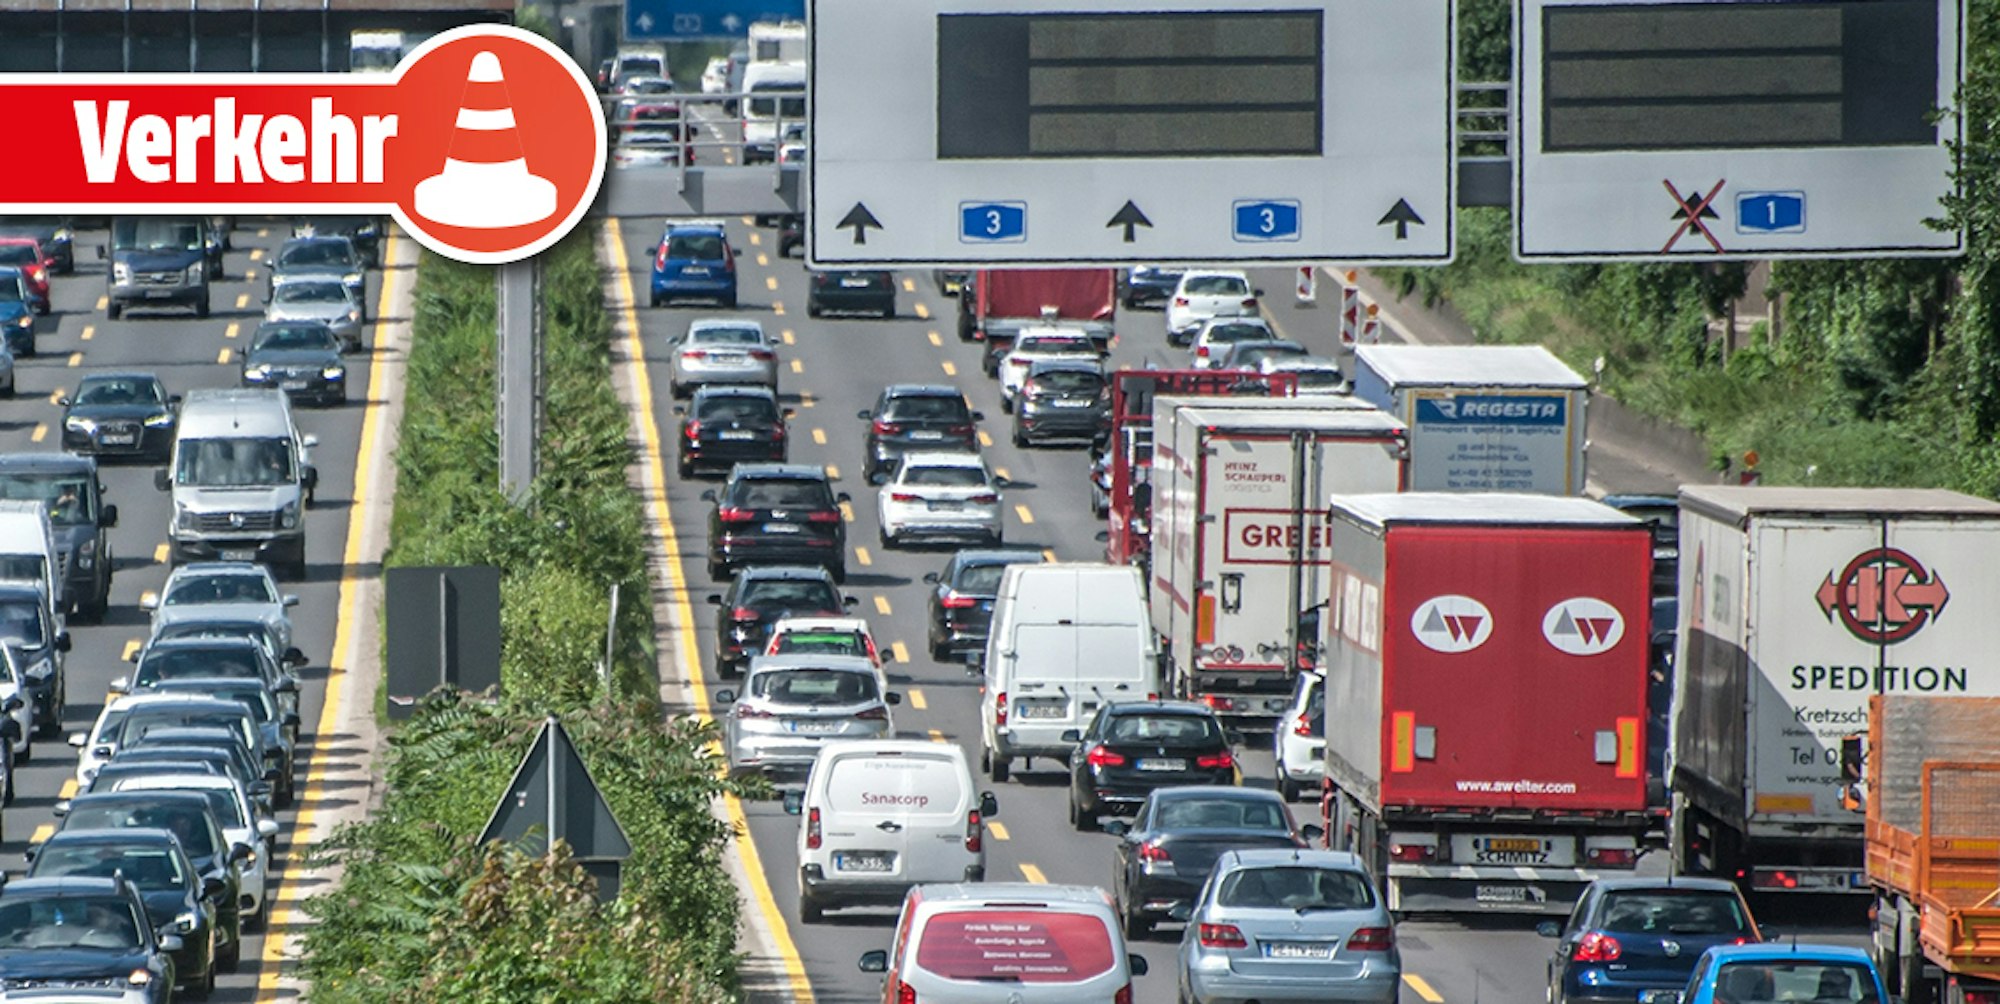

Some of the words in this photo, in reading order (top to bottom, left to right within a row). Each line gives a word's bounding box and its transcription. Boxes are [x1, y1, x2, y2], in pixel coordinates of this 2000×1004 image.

[1259, 208, 1275, 233] 3
[1766, 200, 1776, 225] 1
[985, 209, 1001, 235] 3
[1462, 402, 1557, 418] REGESTA
[1225, 463, 1257, 471] HEINZ
[1791, 666, 1967, 692] SPEDITION
[1790, 747, 1815, 765] Tel
[862, 792, 929, 808] Sanacorp
[1476, 850, 1548, 863] SCHMITZ
